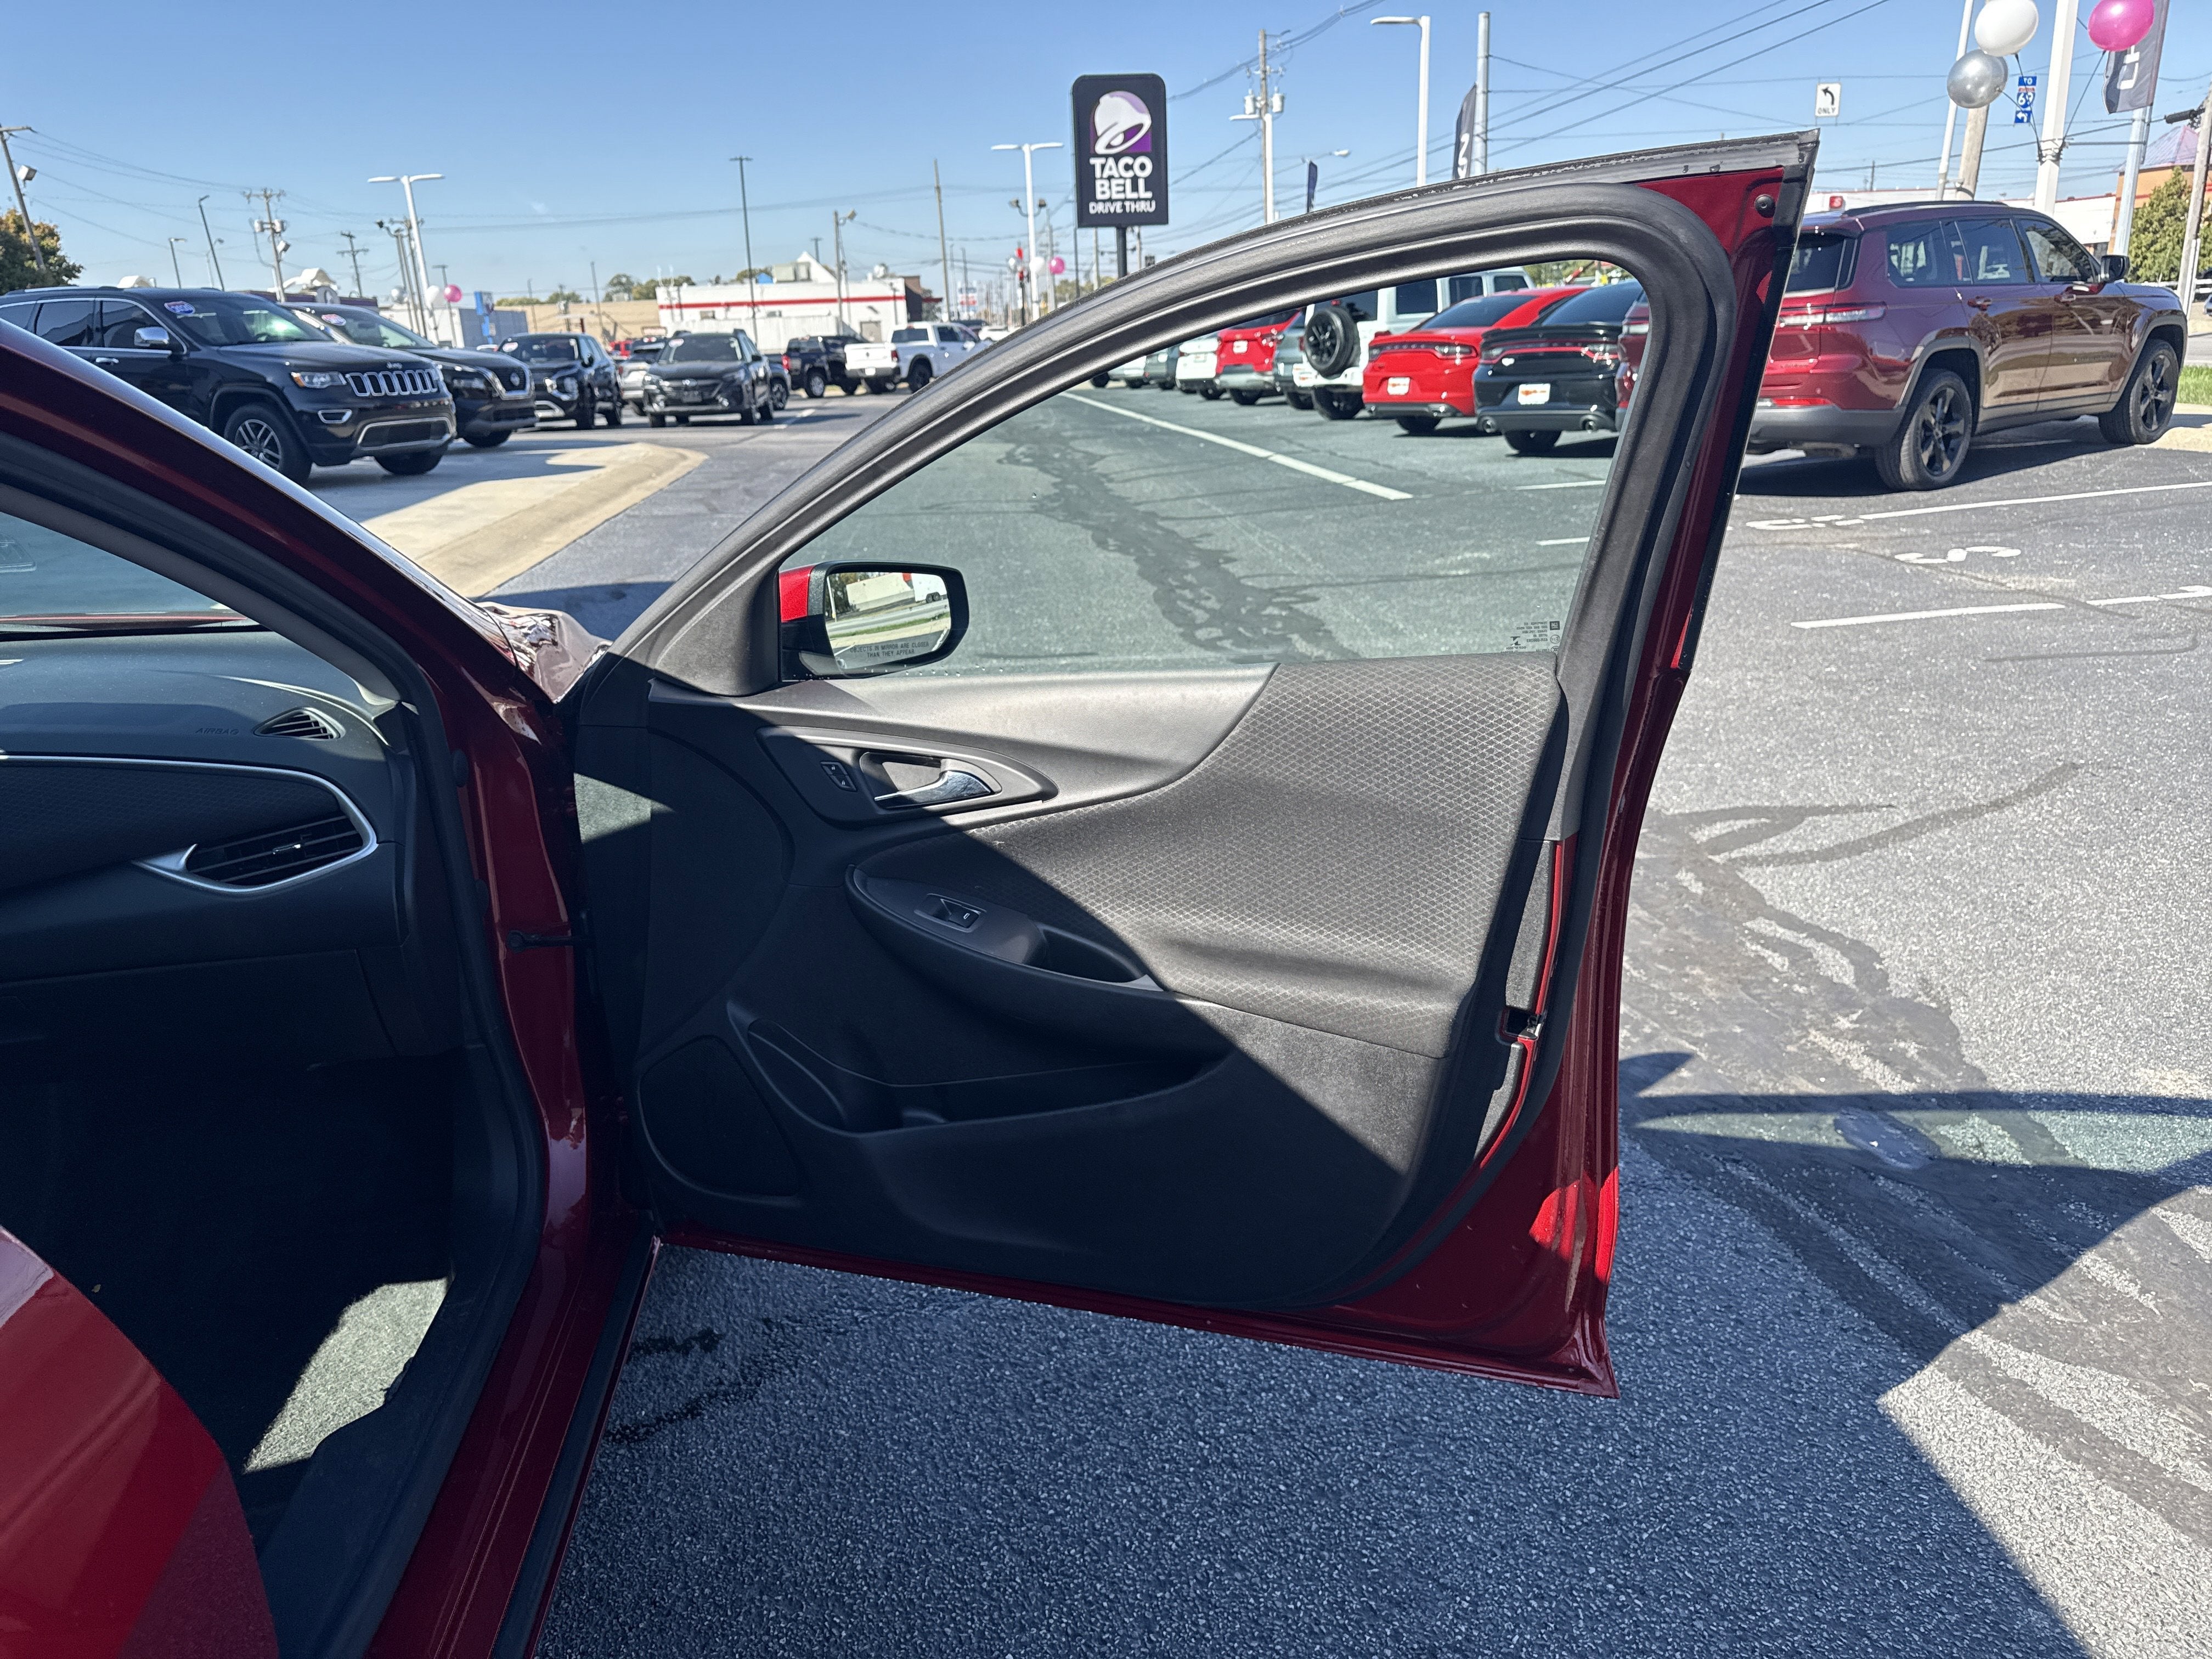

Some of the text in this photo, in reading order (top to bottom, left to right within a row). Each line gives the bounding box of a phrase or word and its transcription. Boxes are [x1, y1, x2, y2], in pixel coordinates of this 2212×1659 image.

[2018, 92, 2033, 106] 69
[1089, 156, 1153, 178] TACO
[1095, 178, 1153, 200] BELL
[1088, 200, 1156, 214] DRIVE THRU
